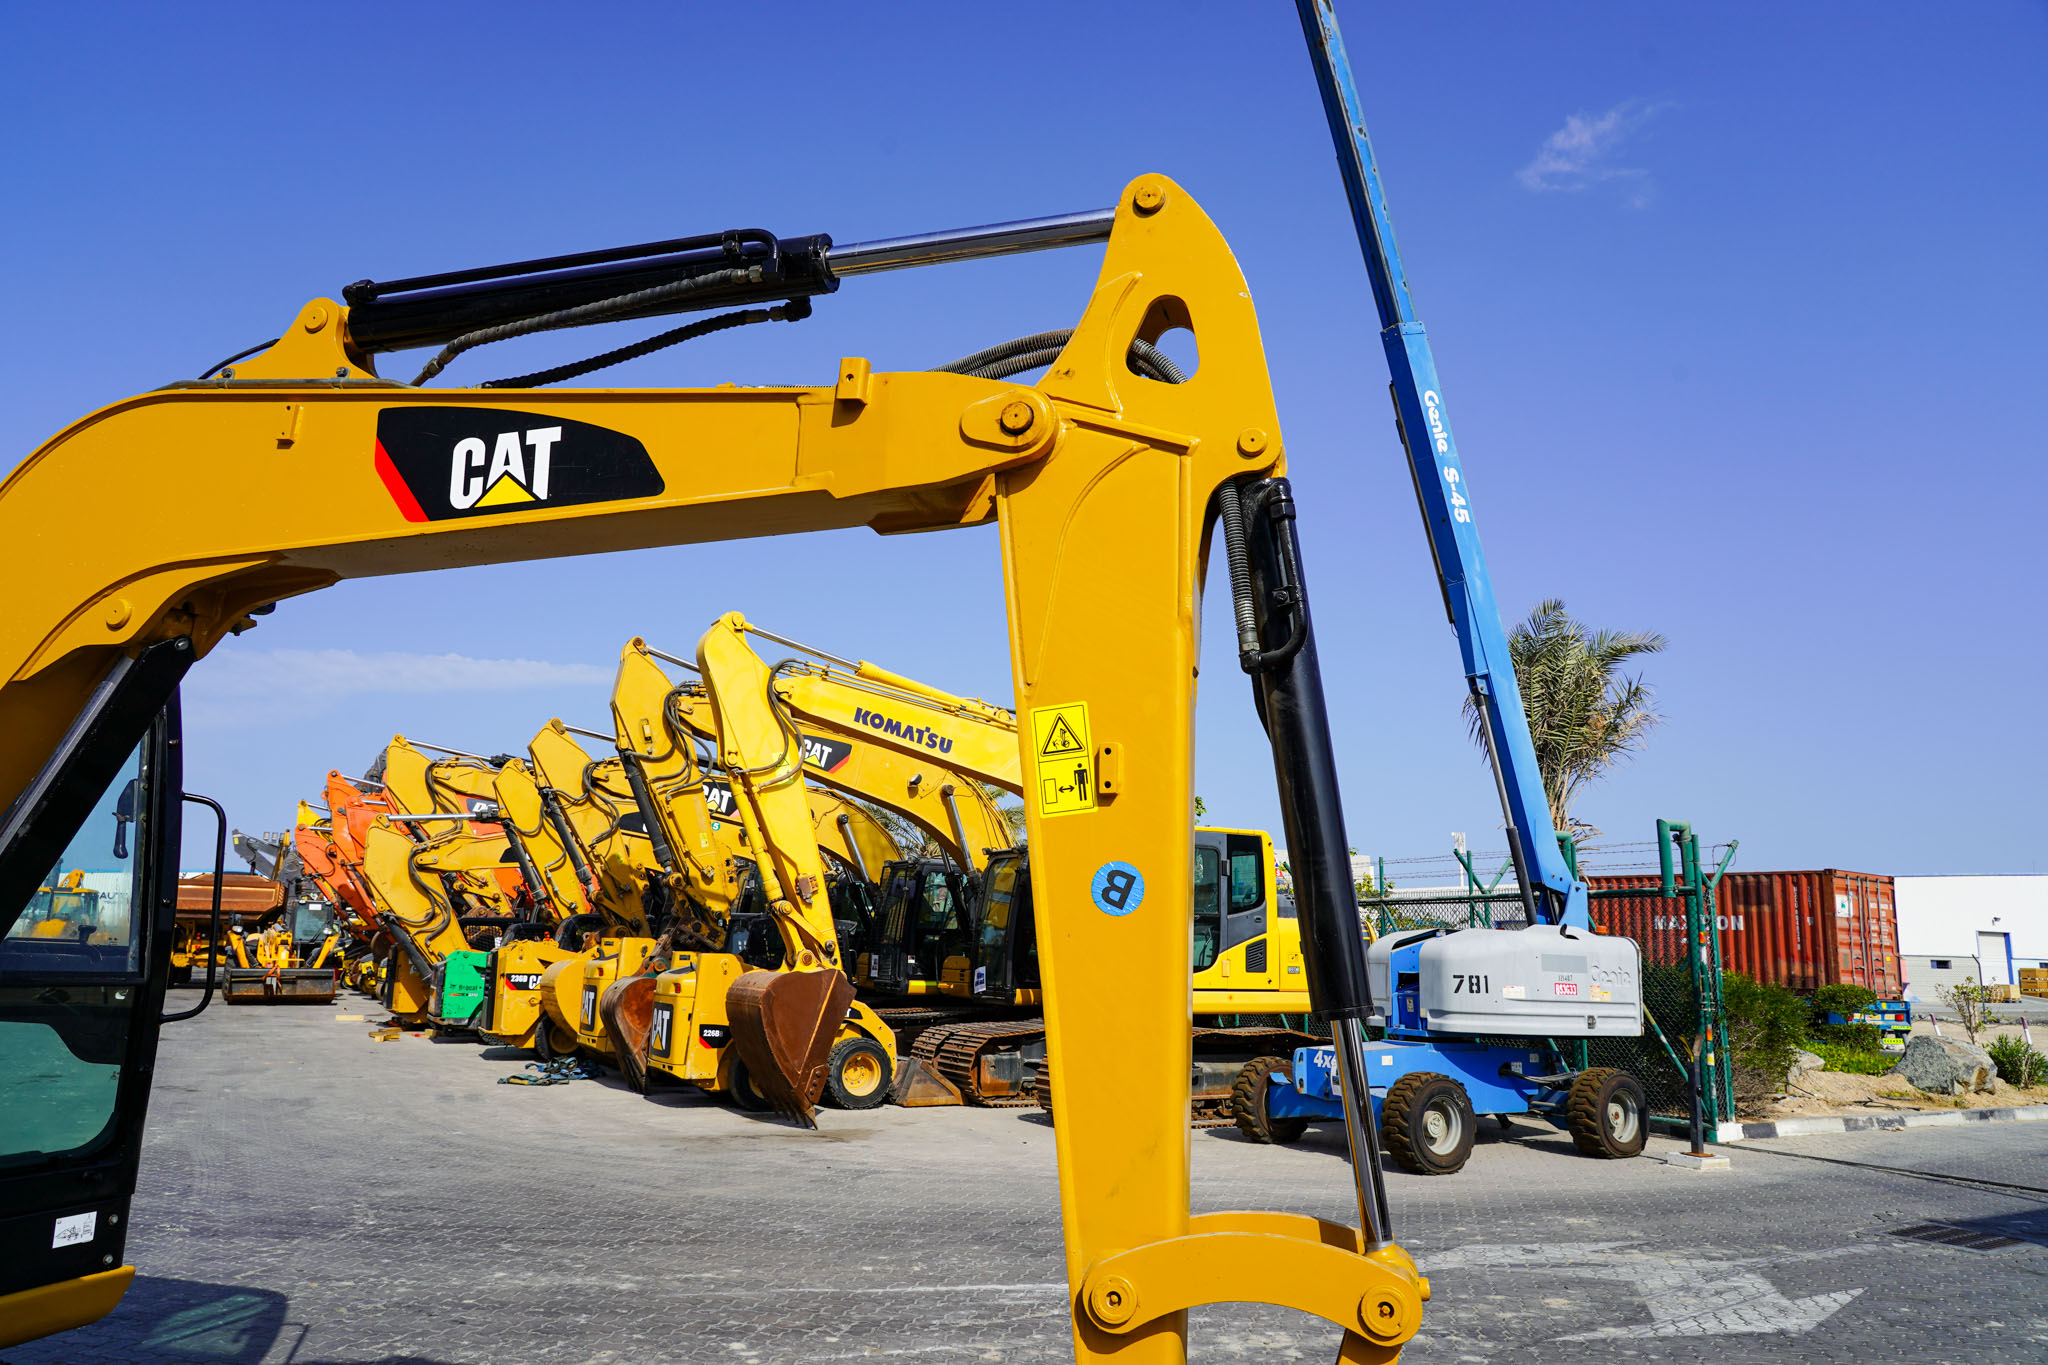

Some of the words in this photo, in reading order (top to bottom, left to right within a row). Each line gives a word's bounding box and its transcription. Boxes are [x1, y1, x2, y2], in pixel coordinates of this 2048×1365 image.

[450, 426, 562, 510] CAT
[1424, 390, 1448, 453] Genie
[1443, 466, 1470, 523] S-45
[853, 707, 953, 754] KOMATSU
[1101, 869, 1136, 910] B
[1453, 975, 1489, 994] 781
